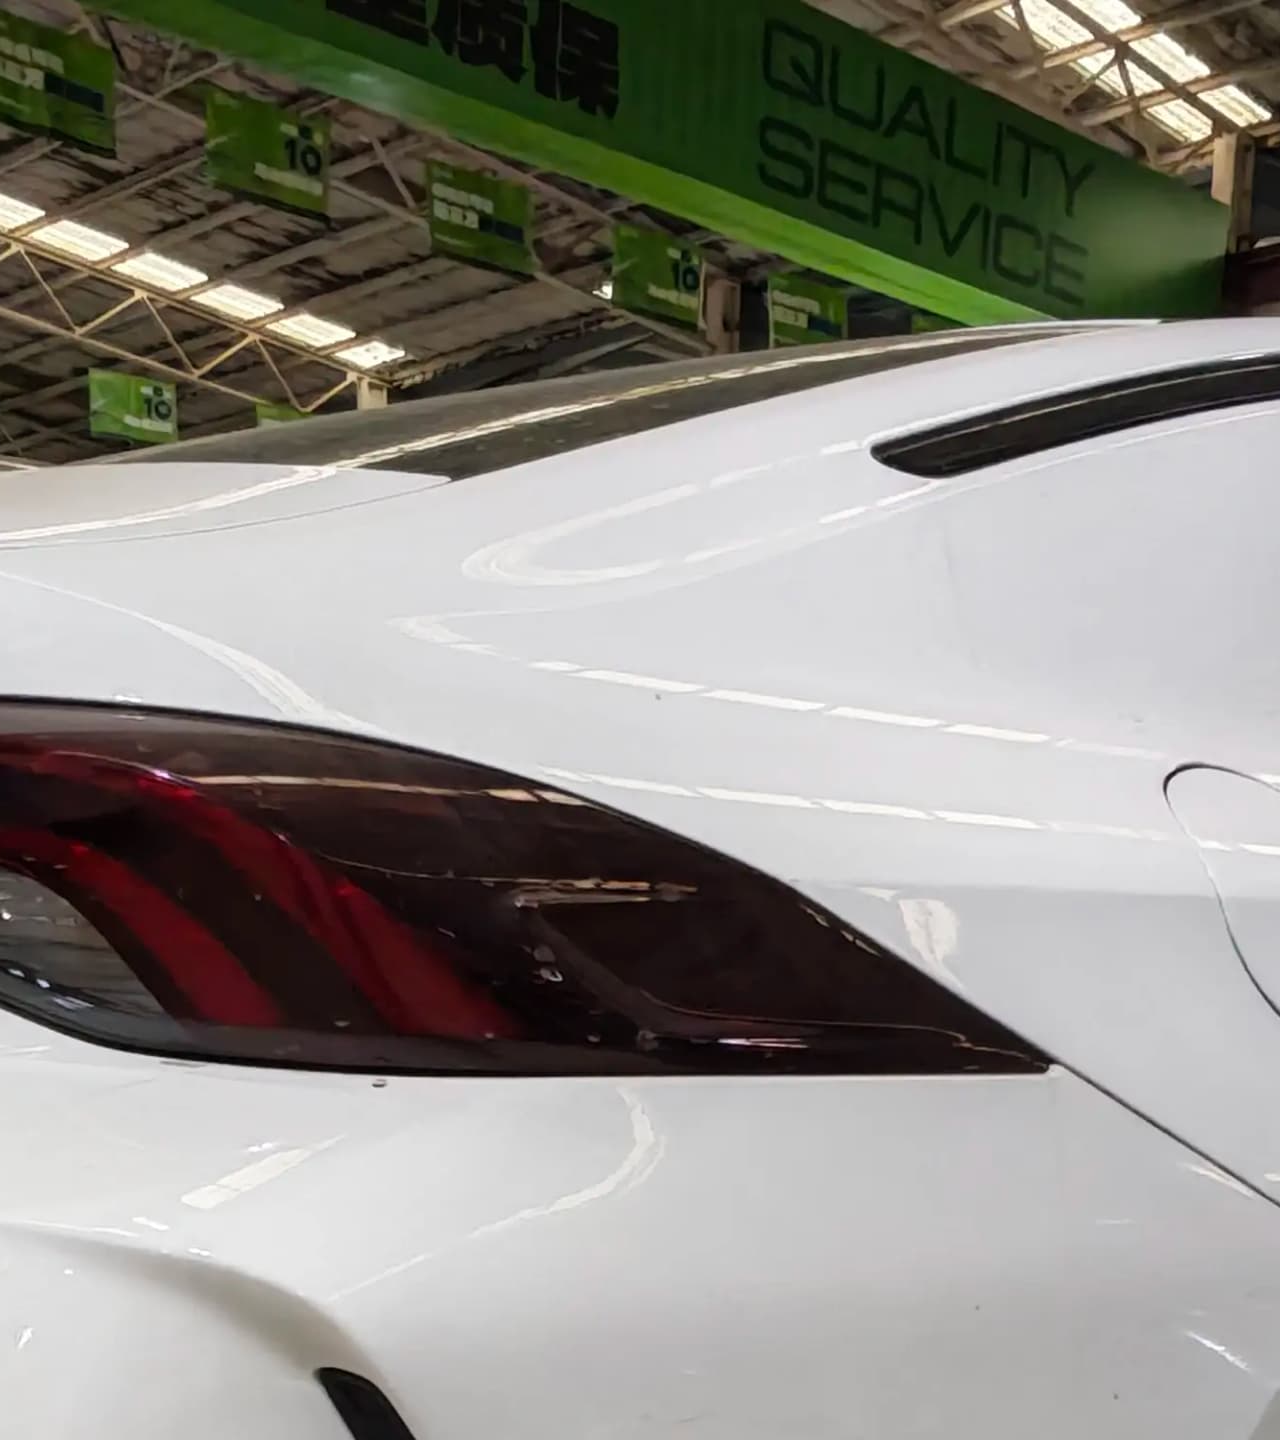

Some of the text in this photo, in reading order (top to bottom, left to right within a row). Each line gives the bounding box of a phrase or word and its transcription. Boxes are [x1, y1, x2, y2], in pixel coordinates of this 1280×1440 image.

[756, 115, 1090, 307] SERVICE
[762, 18, 1096, 218] QUALITY
[144, 396, 172, 420] 10
